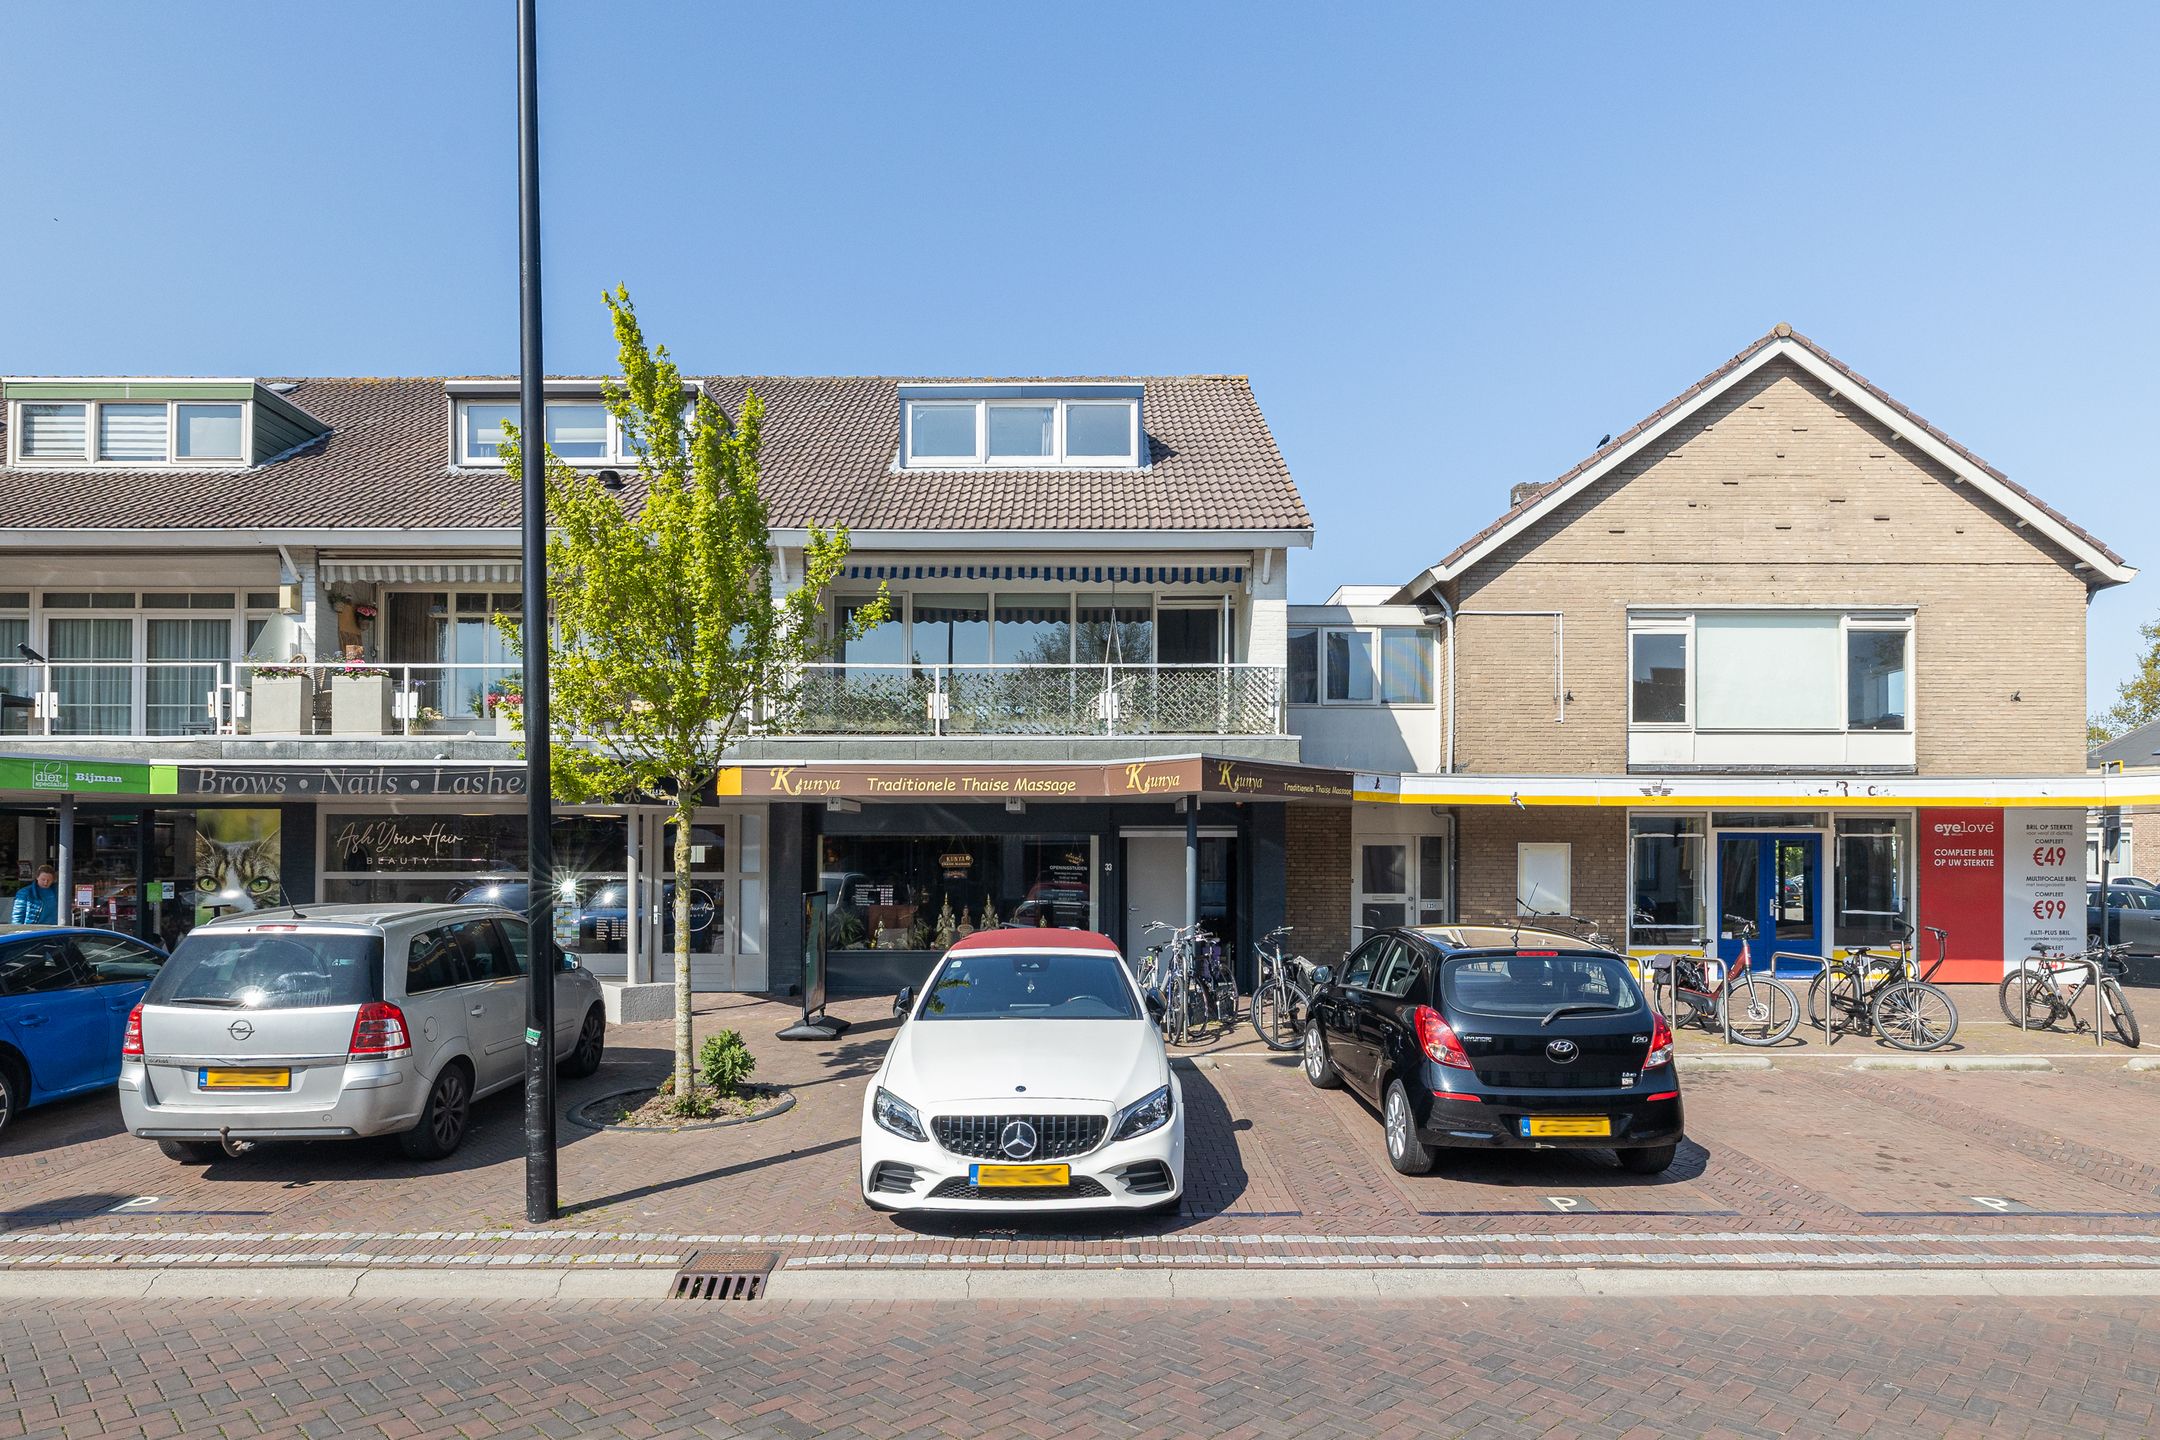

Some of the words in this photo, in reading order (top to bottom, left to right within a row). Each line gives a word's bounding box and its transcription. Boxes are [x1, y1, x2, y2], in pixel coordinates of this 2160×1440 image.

[35, 771, 63, 782] dier
[74, 772, 123, 784] Bijman
[196, 767, 287, 794] Brows
[319, 766, 399, 795] Nails
[431, 766, 525, 795] Lashe
[769, 767, 841, 796] Kunya
[867, 777, 957, 792] Traditionele
[961, 777, 1009, 792] Thaise
[1013, 777, 1077, 795] Massage
[1125, 763, 1181, 794] Kunya
[1218, 761, 1263, 793] Kunya
[1934, 820, 1995, 836] eyelove
[336, 821, 375, 860] Ash
[375, 821, 422, 853] Your
[422, 822, 464, 856] Hair
[366, 857, 430, 865] BEAUTY
[1934, 848, 1977, 857] COMPLETE
[1978, 848, 1995, 857] BRIL
[2032, 846, 2066, 867] €49
[1104, 863, 1113, 871] 33
[1934, 858, 1947, 867] OP
[1948, 858, 1962, 867] UW
[1963, 858, 1995, 867] STERKTE
[2032, 900, 2066, 920] €99
